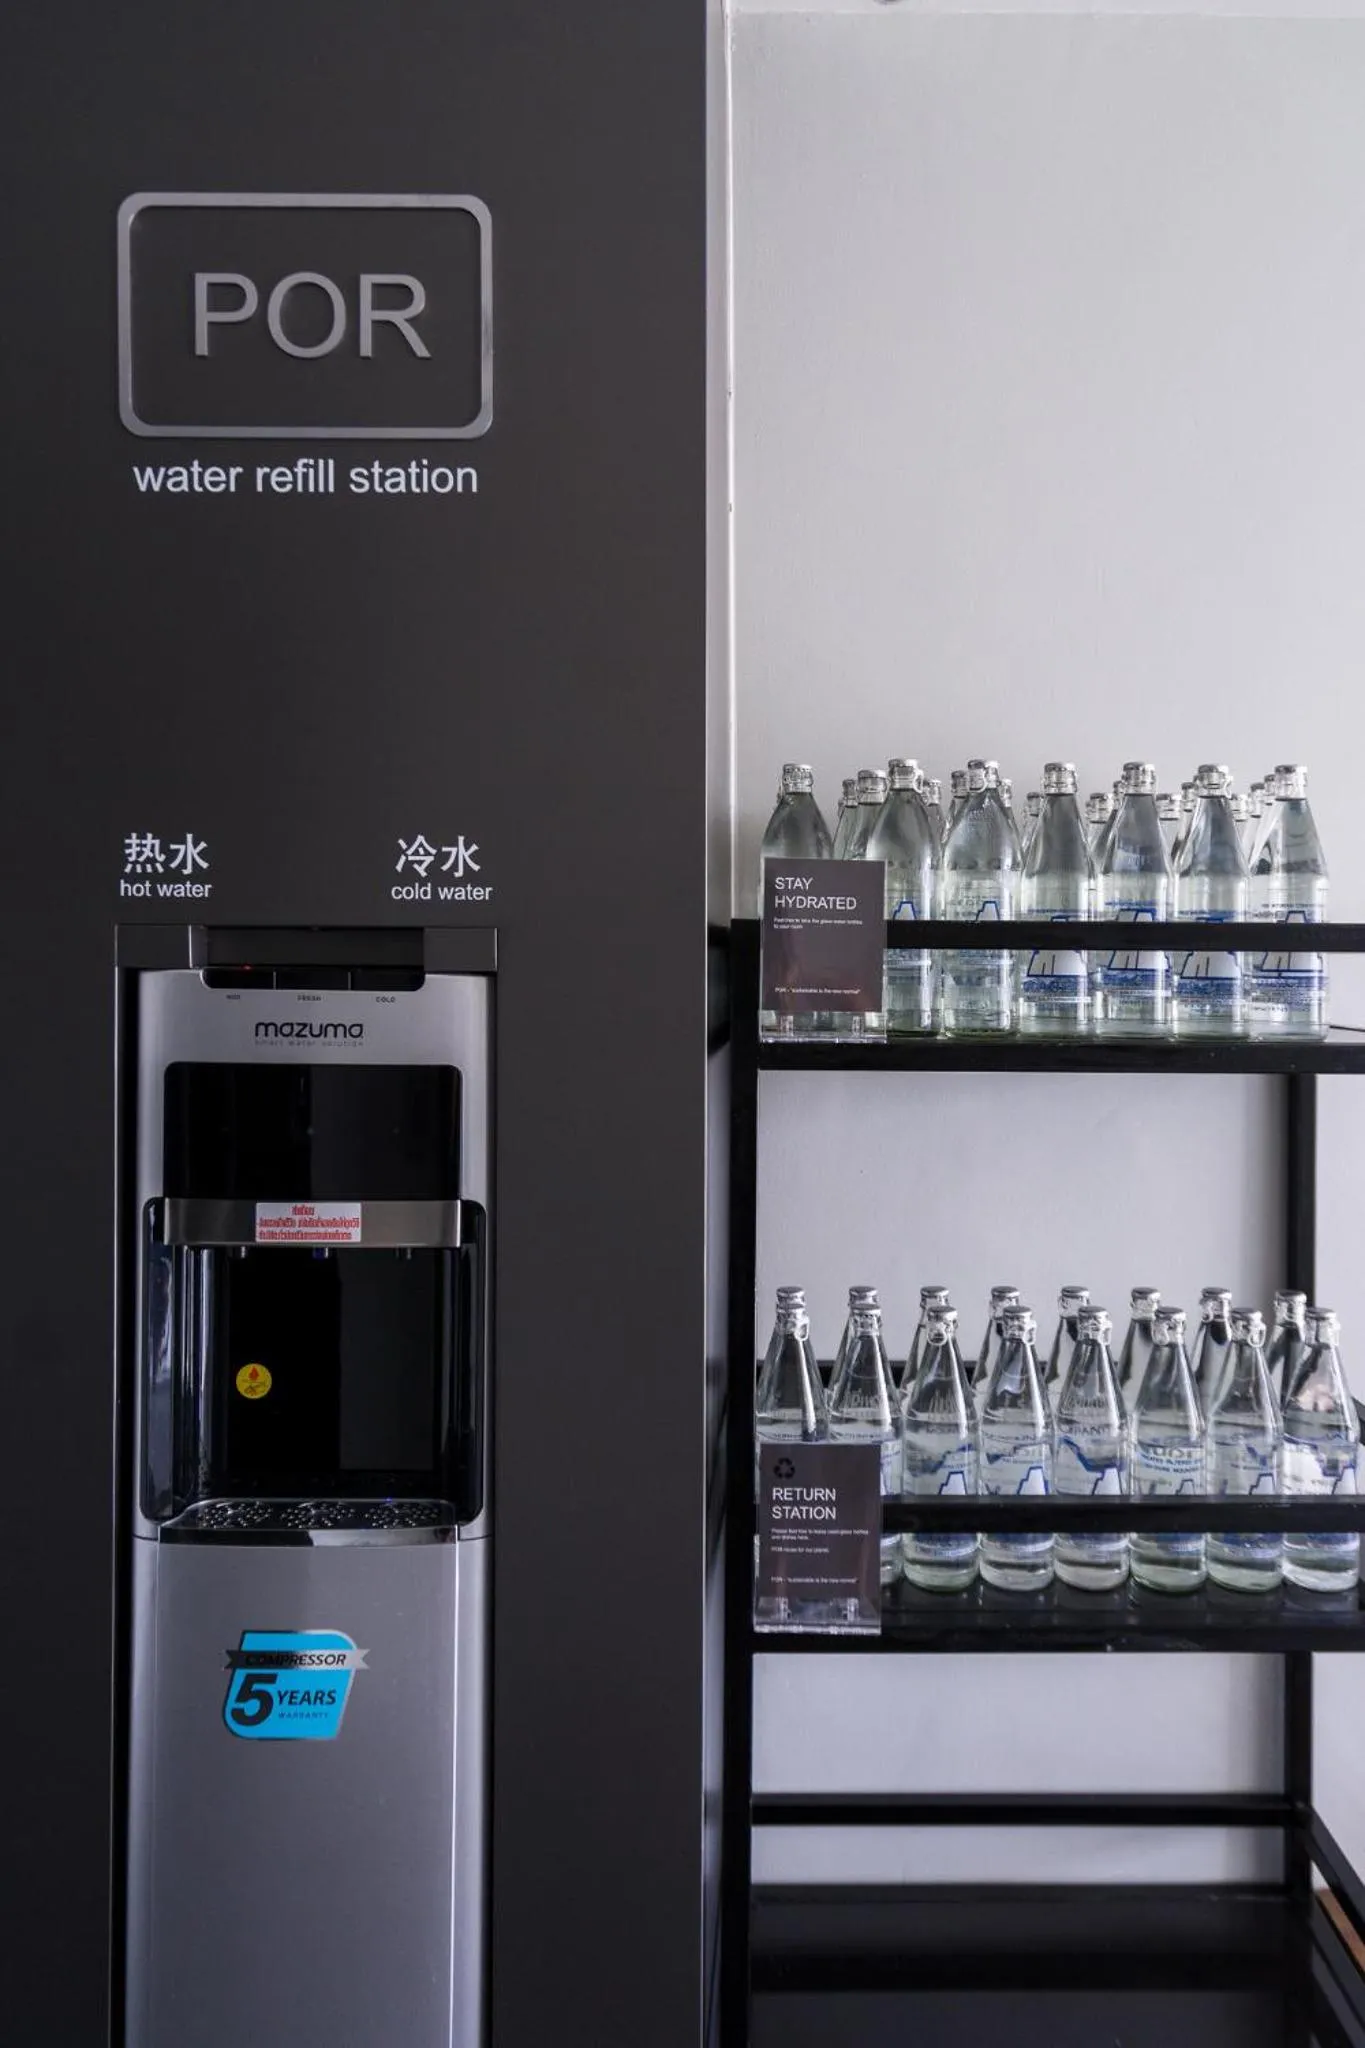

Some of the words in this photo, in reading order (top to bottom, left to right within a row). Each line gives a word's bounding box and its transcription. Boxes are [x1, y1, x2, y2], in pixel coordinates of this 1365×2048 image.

[194, 271, 431, 359] POR
[133, 460, 243, 493] water
[256, 459, 334, 493] refill
[350, 459, 477, 494] station
[124, 832, 210, 875] 热水
[395, 834, 480, 878] 冷水
[120, 880, 151, 897] hot
[157, 881, 212, 898] water
[391, 882, 431, 900] cold
[438, 884, 493, 901] water
[775, 877, 813, 890] STAY
[775, 896, 857, 910] HYDRATED
[255, 1022, 363, 1039] mazuma
[772, 1487, 836, 1501] RETURN
[772, 1506, 836, 1520] STATION
[245, 1654, 347, 1667] COMPRESSOR
[231, 1673, 278, 1726] 5
[277, 1690, 337, 1705] YEARS
